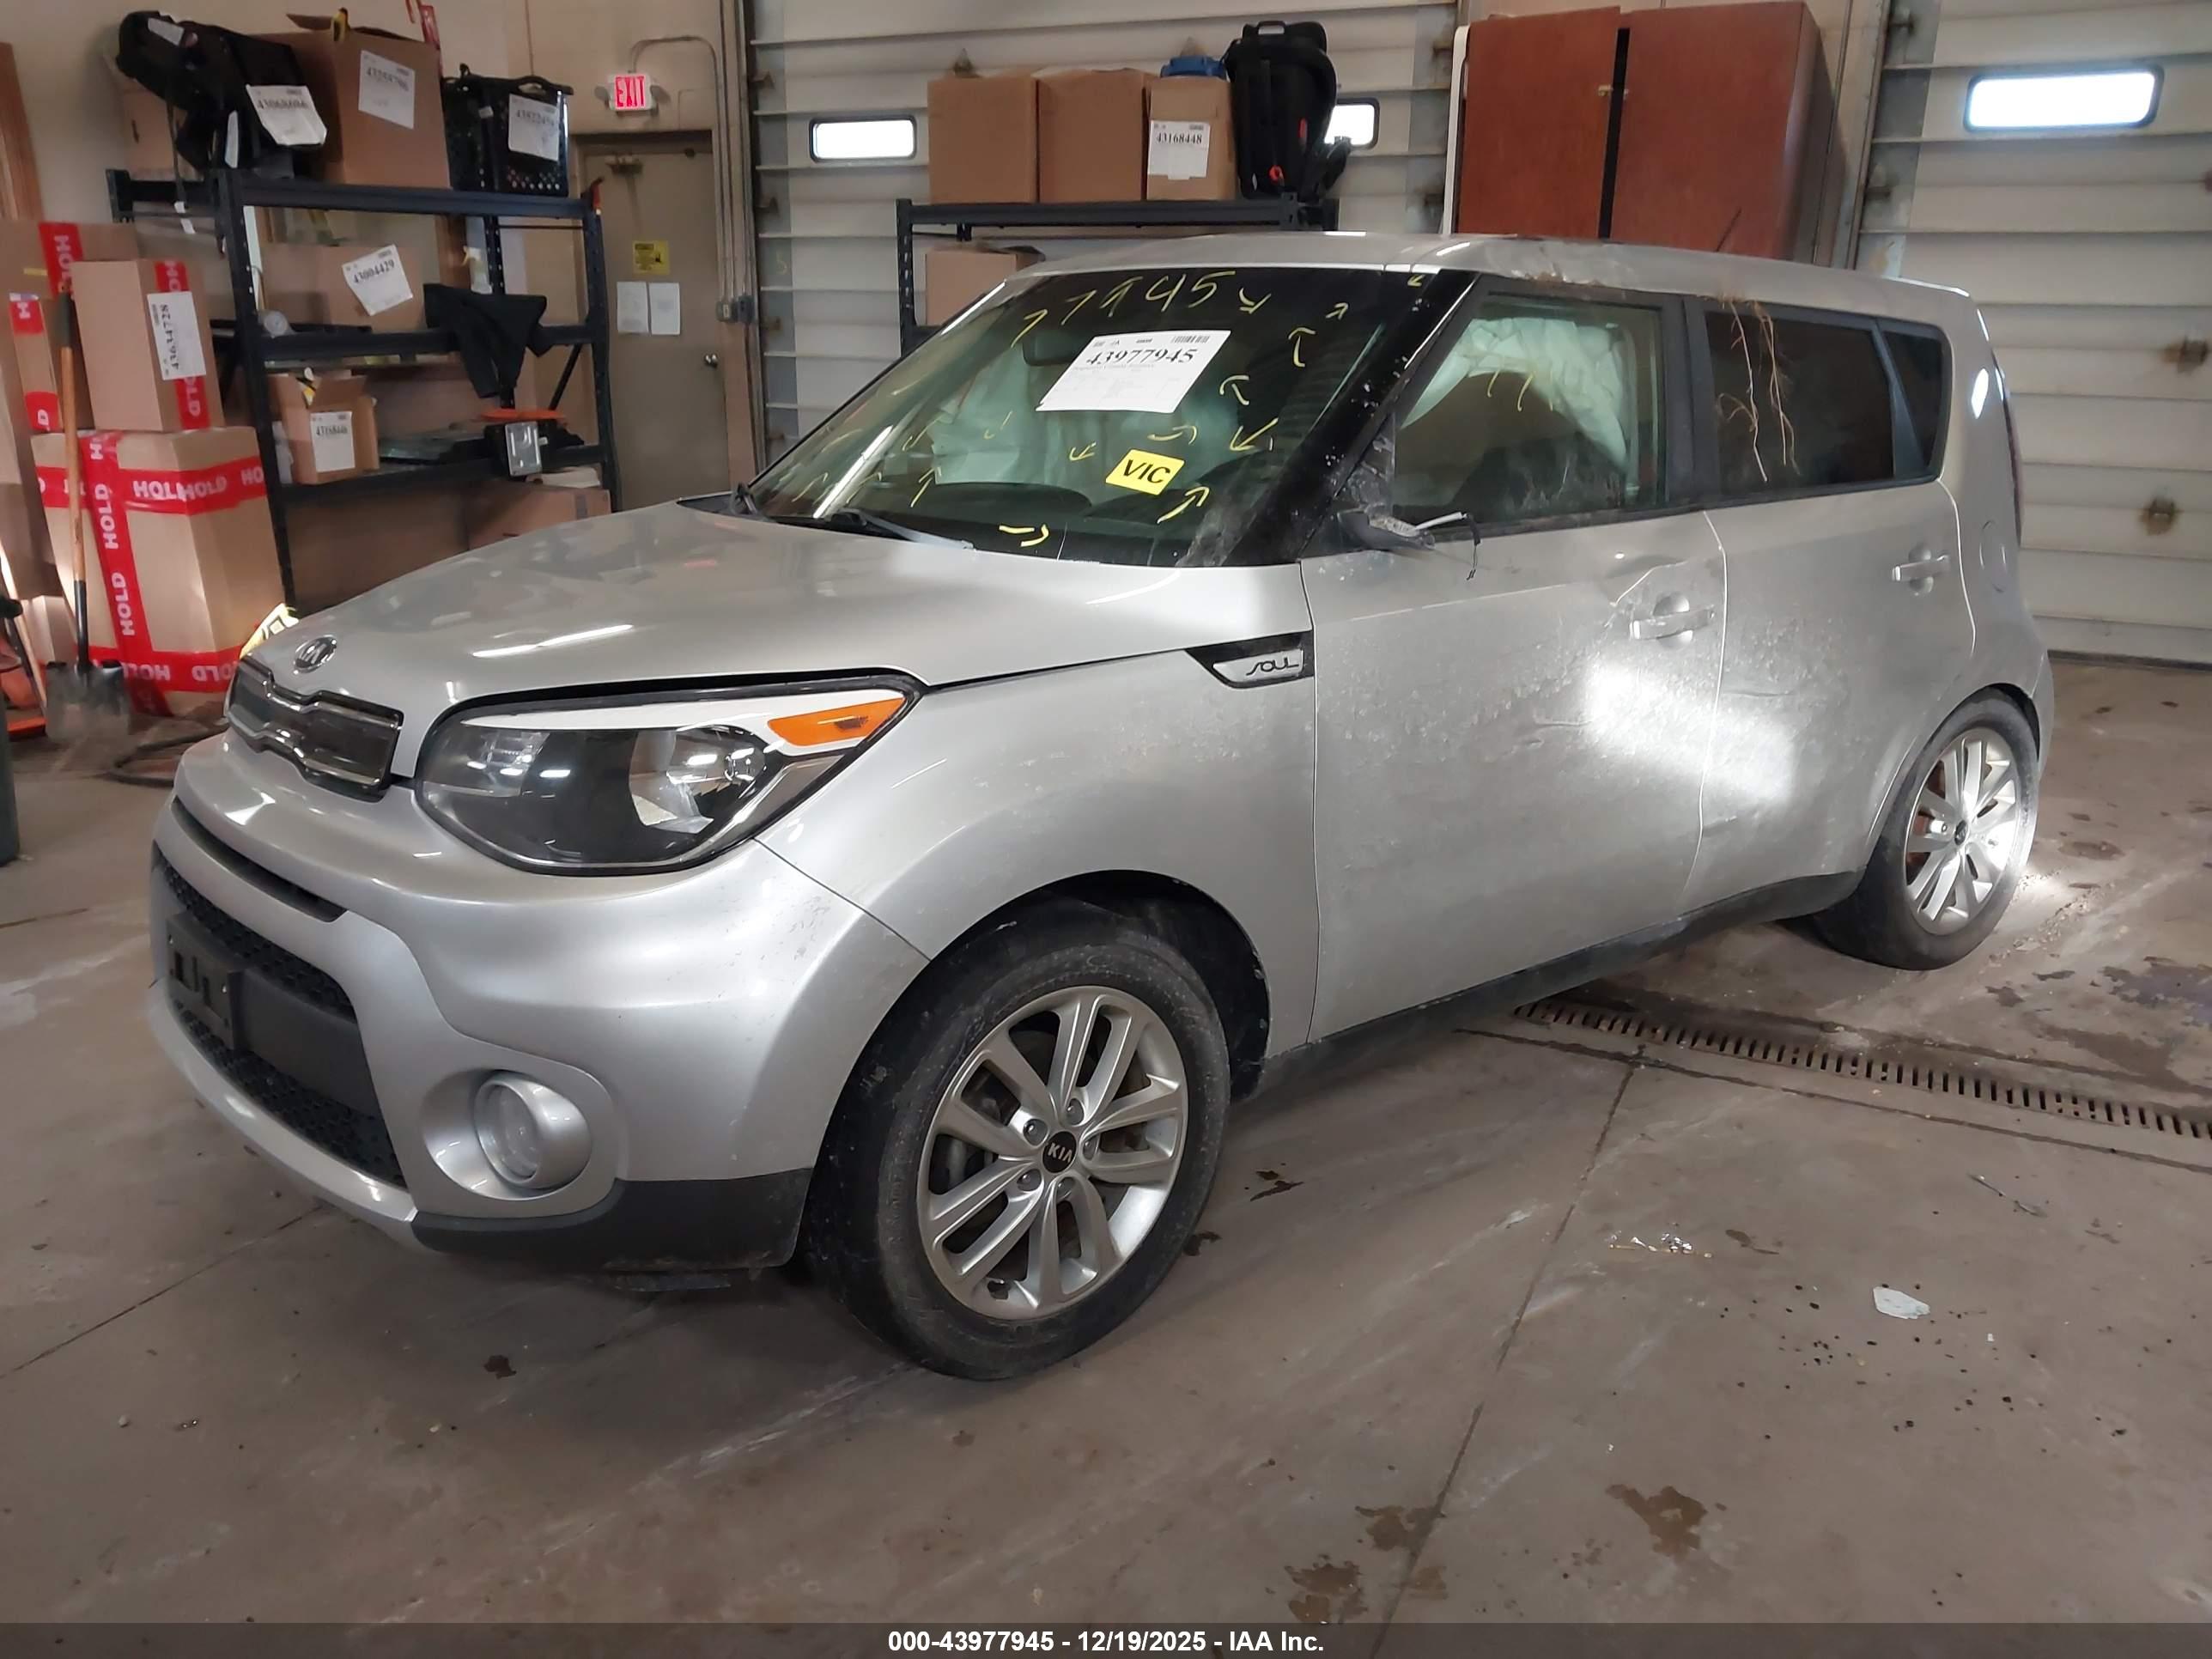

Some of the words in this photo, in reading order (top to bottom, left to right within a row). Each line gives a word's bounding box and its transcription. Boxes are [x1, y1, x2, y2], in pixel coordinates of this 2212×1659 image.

[615, 75, 645, 107] EXIT
[1155, 132, 1203, 144] 43168448
[159, 303, 179, 370] 43634728
[1085, 348, 1198, 366] 43977945
[1123, 459, 1171, 483] VIC
[94, 483, 119, 550] HOLD
[112, 572, 136, 636] HOLD
[1047, 1142, 1073, 1164] KIA
